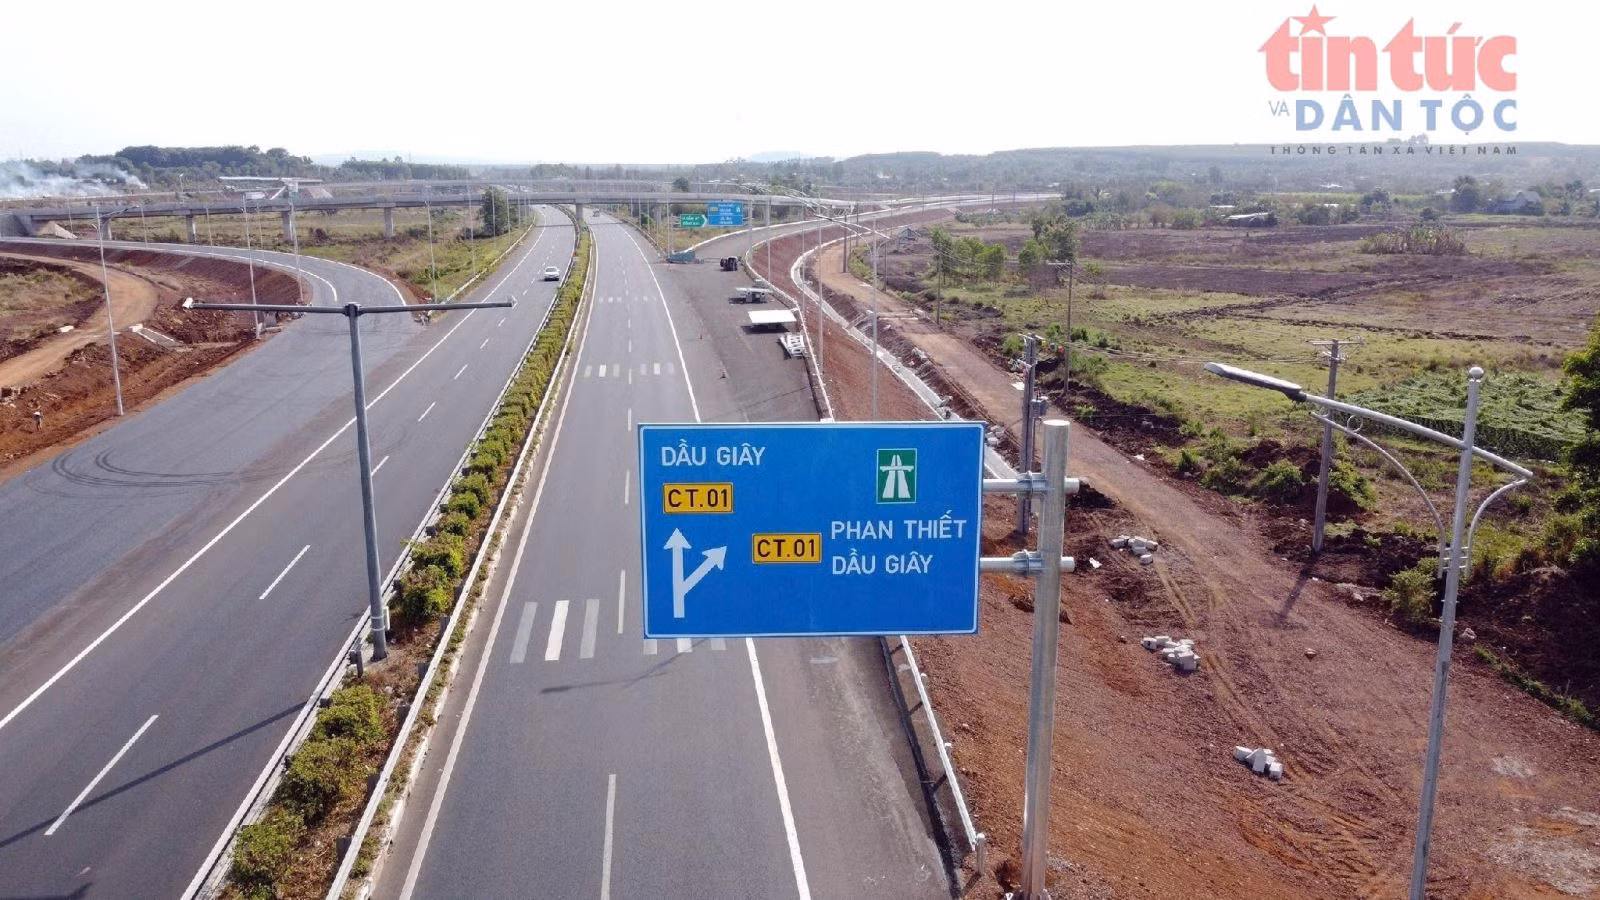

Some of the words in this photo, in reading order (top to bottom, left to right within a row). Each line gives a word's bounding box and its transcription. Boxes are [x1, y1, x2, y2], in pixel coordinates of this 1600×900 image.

[661, 438, 707, 467] DẦU
[716, 442, 766, 466] GIÂY
[668, 488, 728, 508] CT.01
[831, 519, 893, 540] PHAN
[904, 509, 967, 539] THIẾT
[757, 539, 815, 558] CT.01
[831, 547, 876, 575] DẦU
[885, 551, 934, 574] GIÂY
